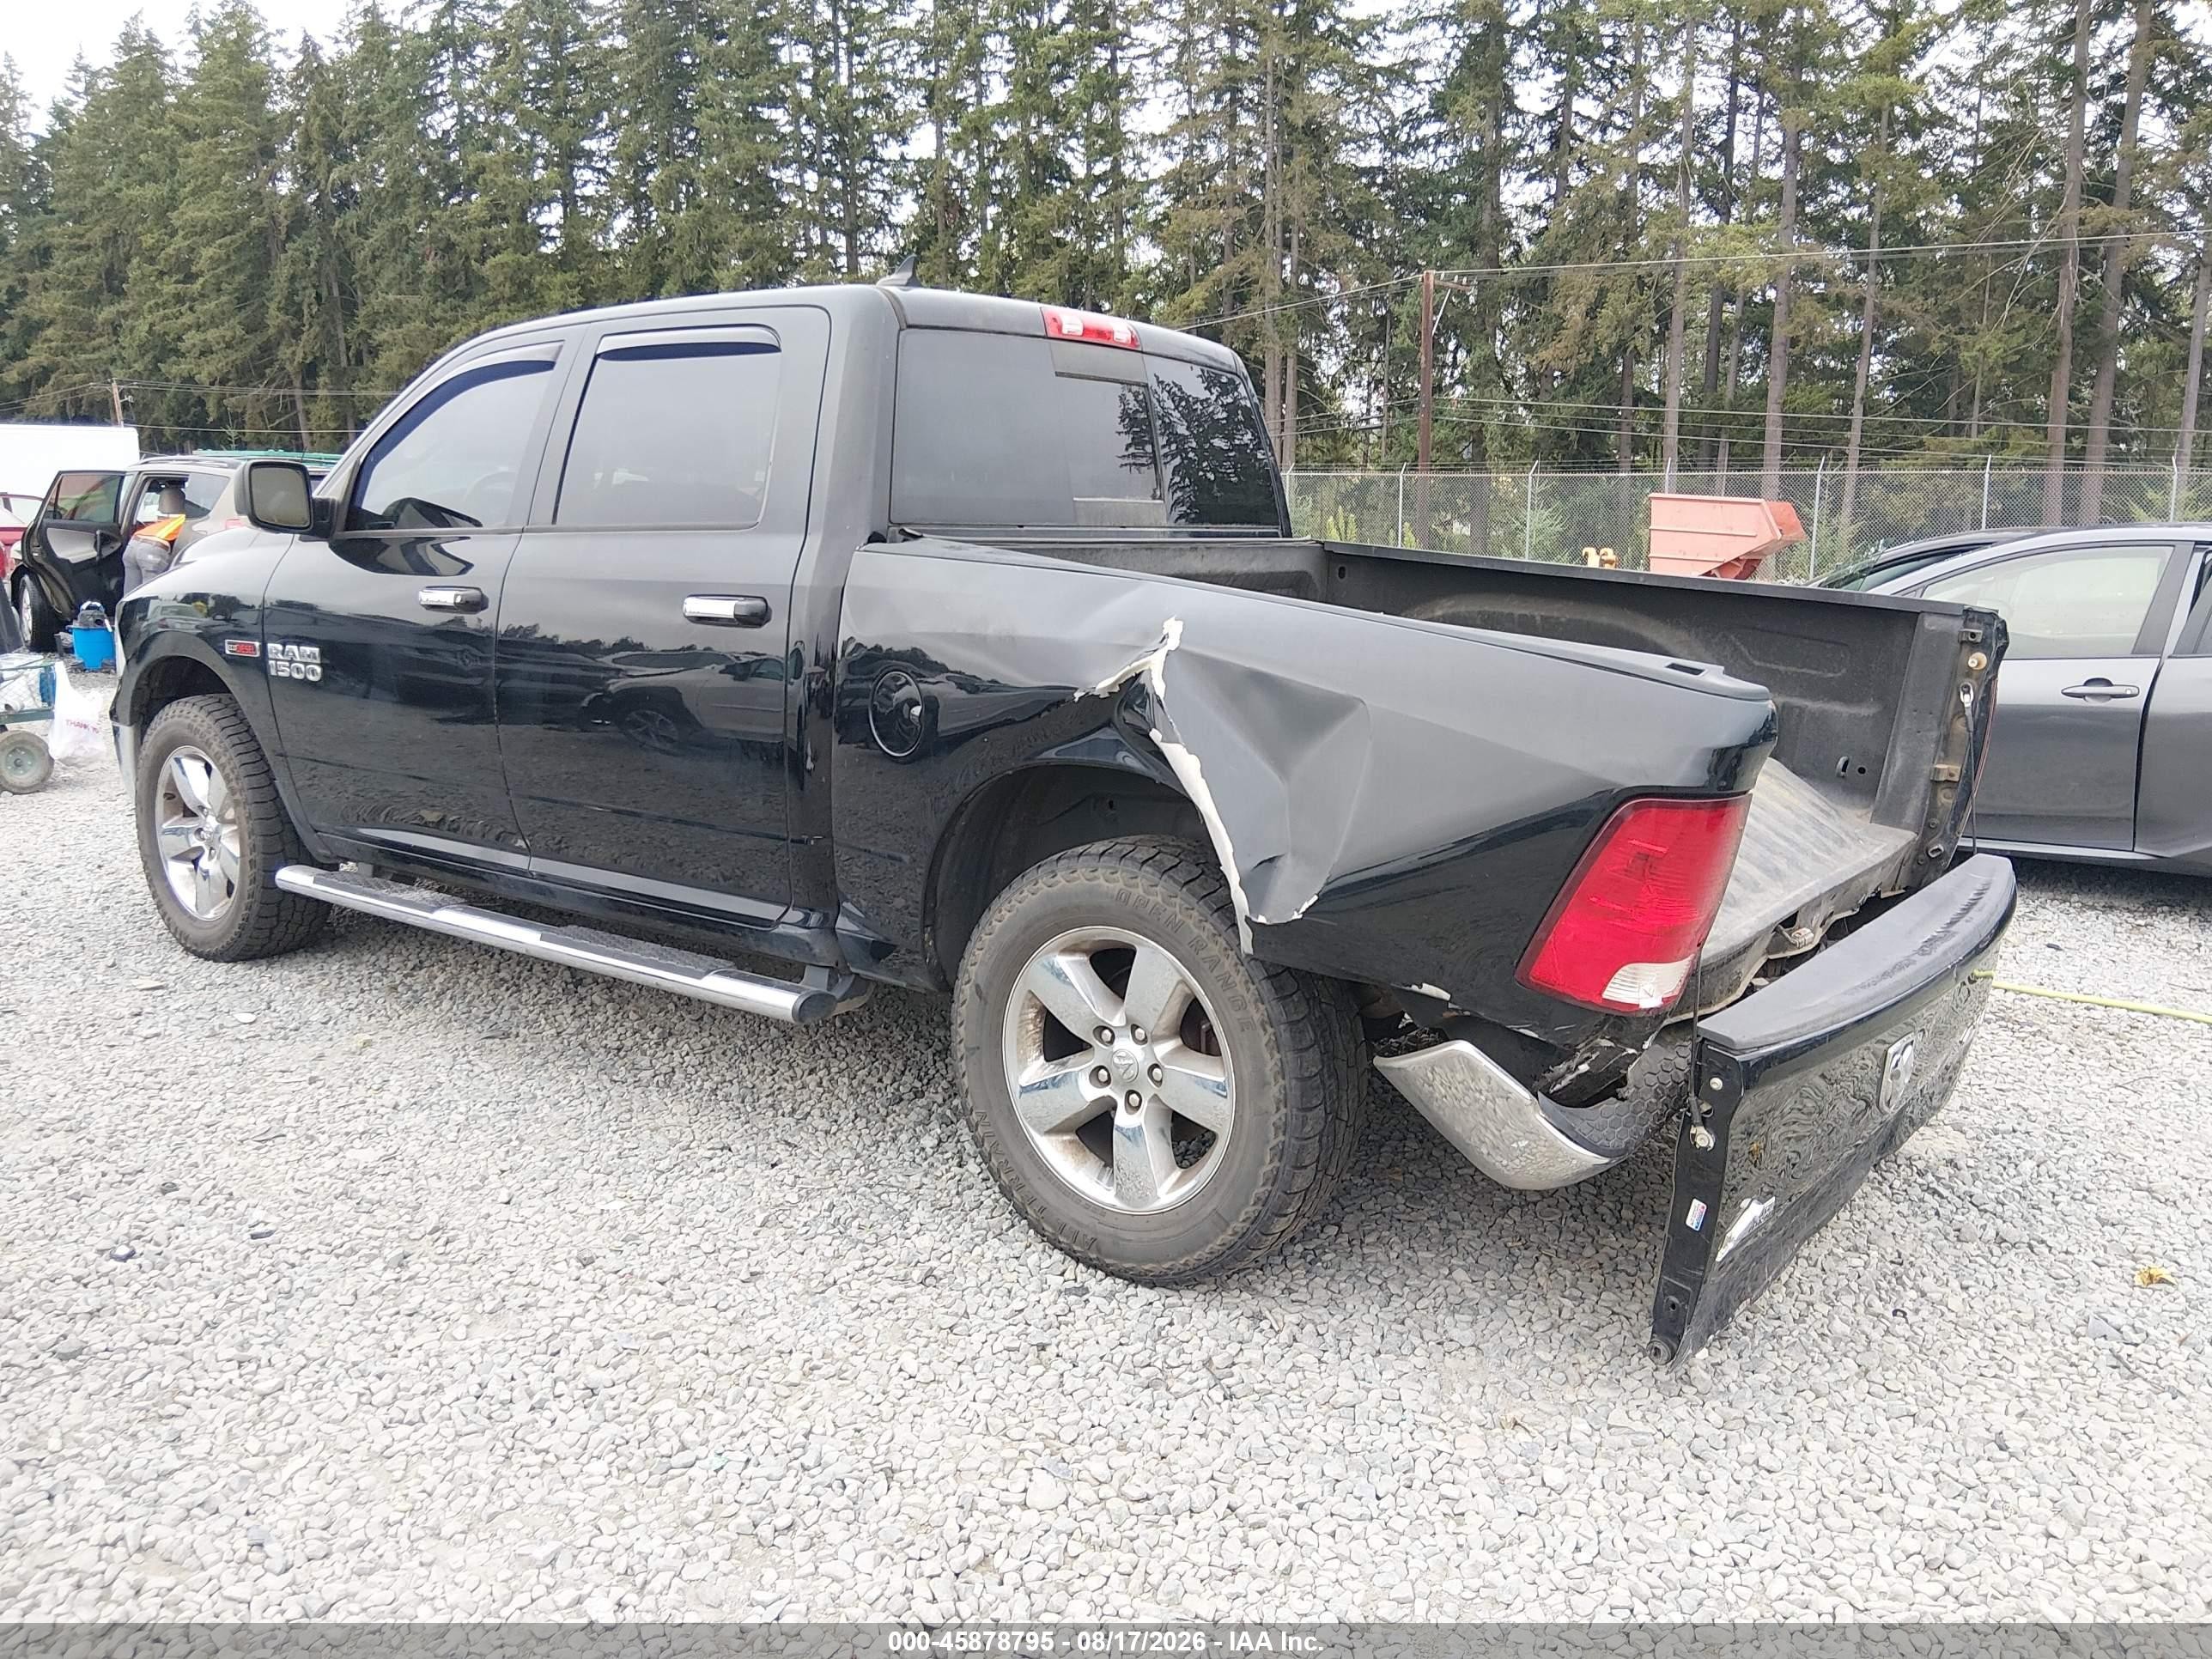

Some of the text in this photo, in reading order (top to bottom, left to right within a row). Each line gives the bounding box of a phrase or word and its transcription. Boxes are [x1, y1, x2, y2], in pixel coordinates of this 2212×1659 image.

[267, 643, 321, 663] RAM
[269, 660, 323, 682] 1500
[1115, 888, 1256, 1033] OPEN RANGE
